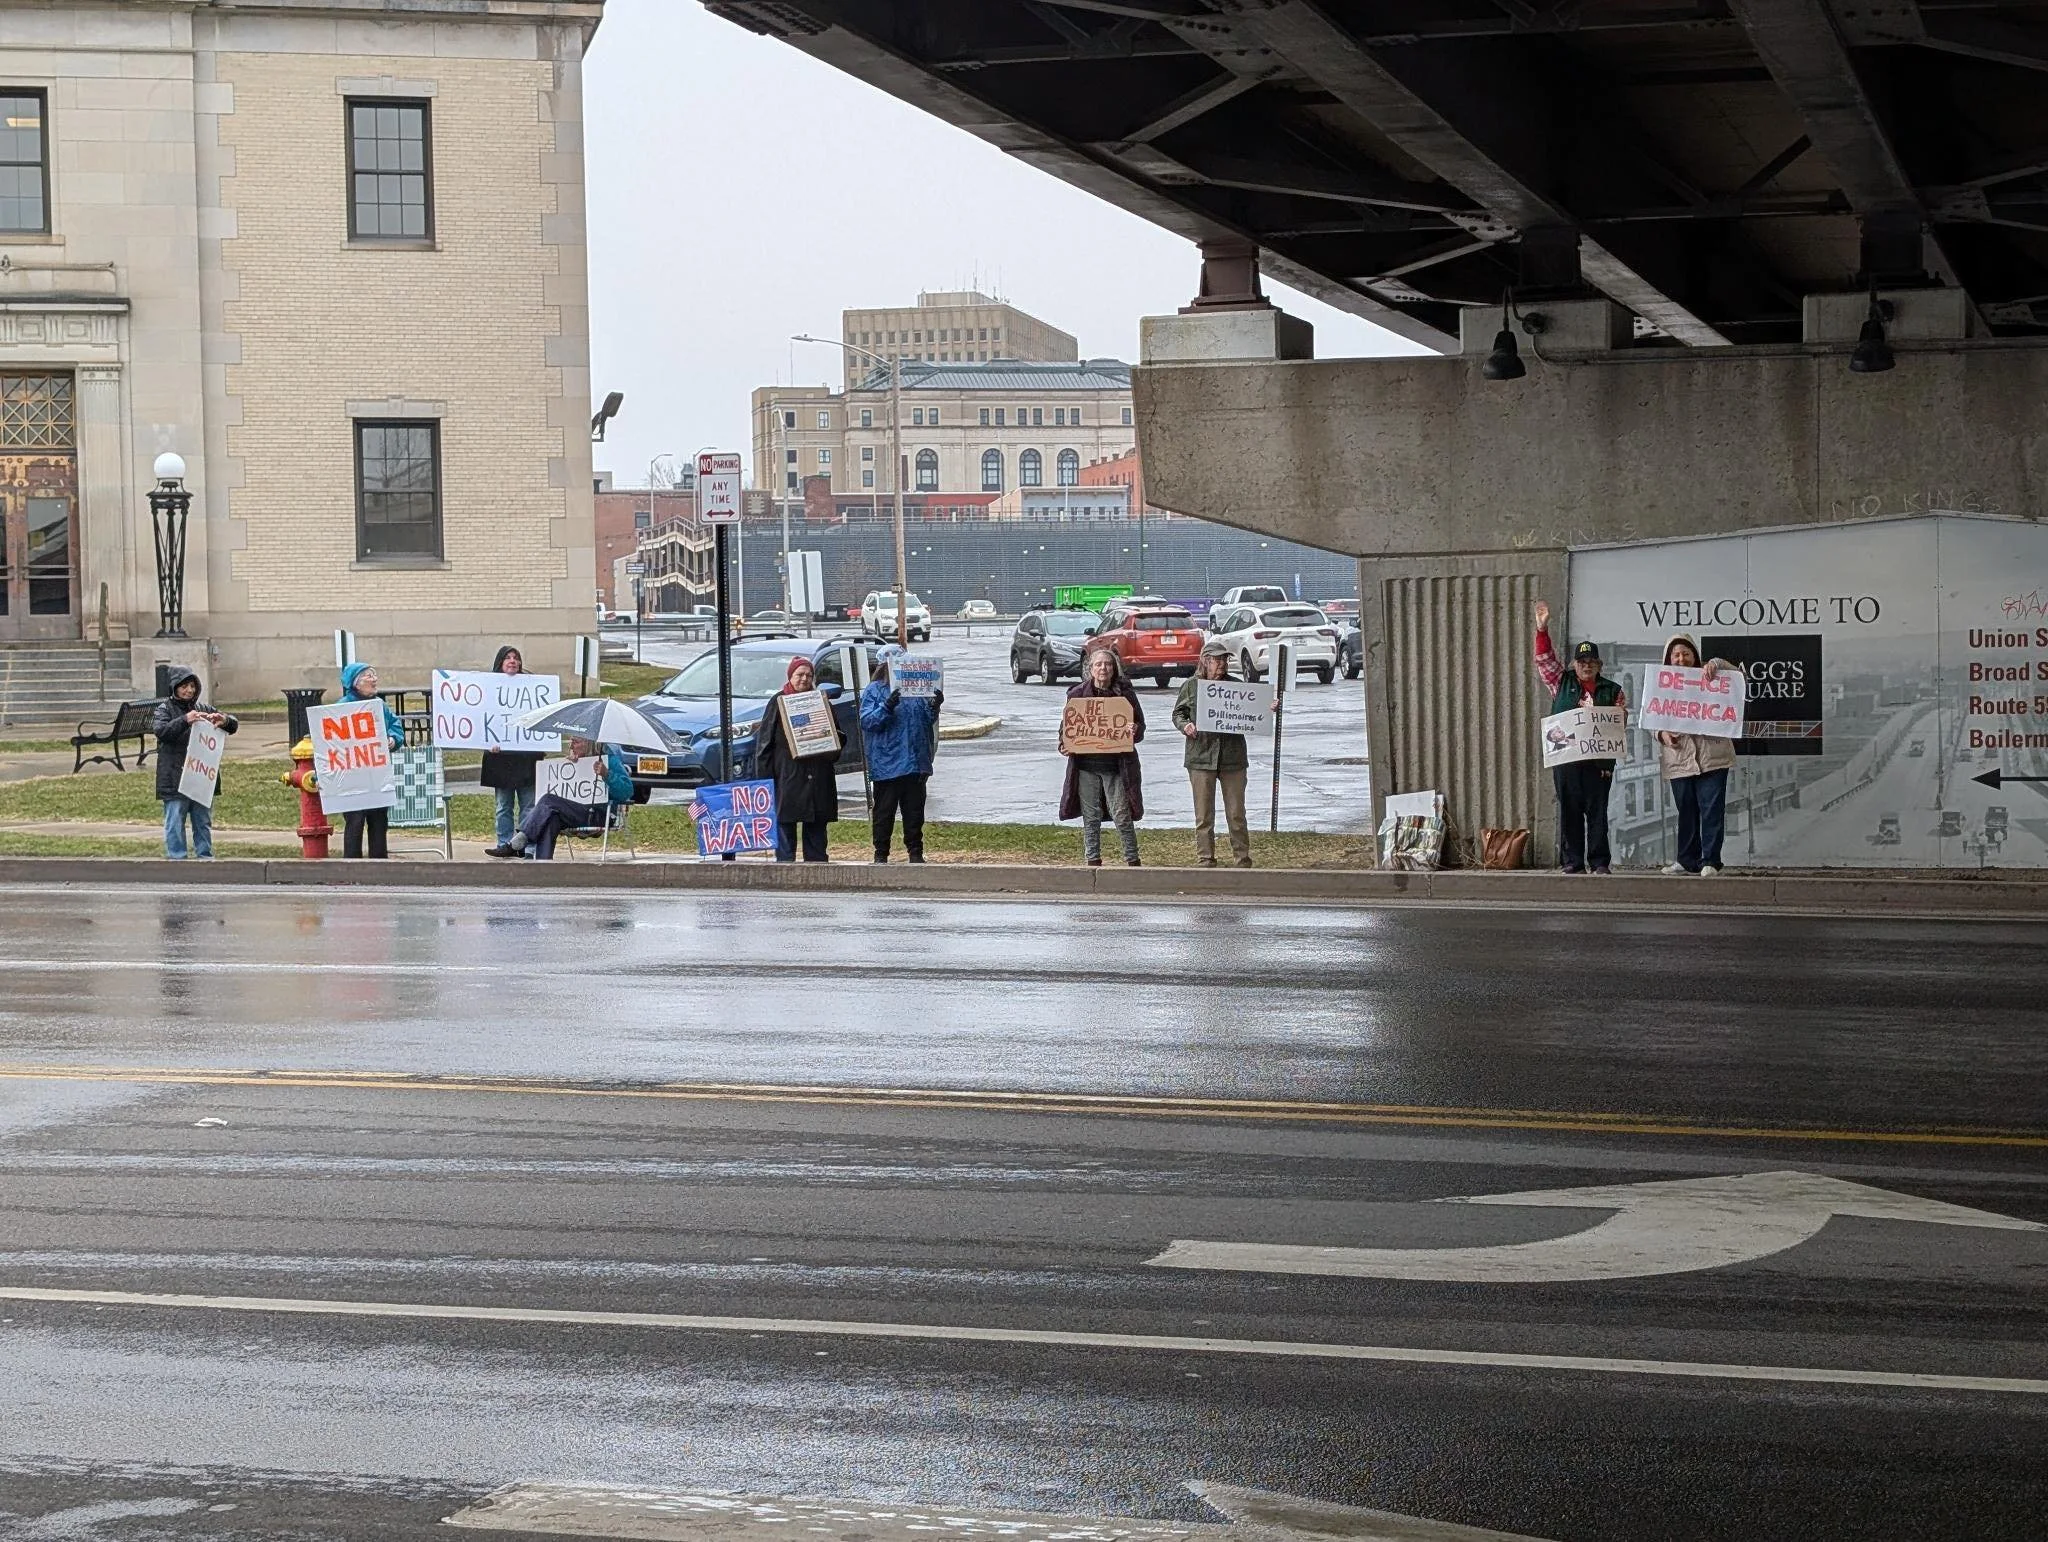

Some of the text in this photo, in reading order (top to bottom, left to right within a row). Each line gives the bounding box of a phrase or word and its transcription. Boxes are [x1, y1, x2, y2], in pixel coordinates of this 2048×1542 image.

[701, 458, 738, 471] NO PARKING
[711, 481, 728, 491] ANY
[710, 494, 730, 504] TIME
[1636, 596, 1880, 627] WELCOME TO
[1969, 628, 2029, 649] Union
[1969, 661, 2030, 682] Broad
[439, 682, 551, 711] NO WAR
[1206, 683, 1256, 702] Starve
[1085, 699, 1104, 716] HE
[1224, 700, 1241, 711] the
[1646, 696, 1737, 723] AMERICA
[1969, 695, 2048, 715] Route 5
[322, 711, 376, 741] NO
[437, 712, 474, 740] NO
[1065, 706, 1128, 728] RAPED
[1574, 711, 1621, 726] I HAVE
[1065, 725, 1131, 740] CHILDREN
[1592, 725, 1603, 737] A
[1969, 728, 2048, 749] Boilerm
[199, 733, 216, 751] NO
[1579, 739, 1625, 755] DREAM
[327, 742, 387, 771] KING
[186, 757, 216, 781] KING
[549, 762, 576, 781] NO
[732, 786, 771, 816] NO
[702, 817, 772, 853] WAR
